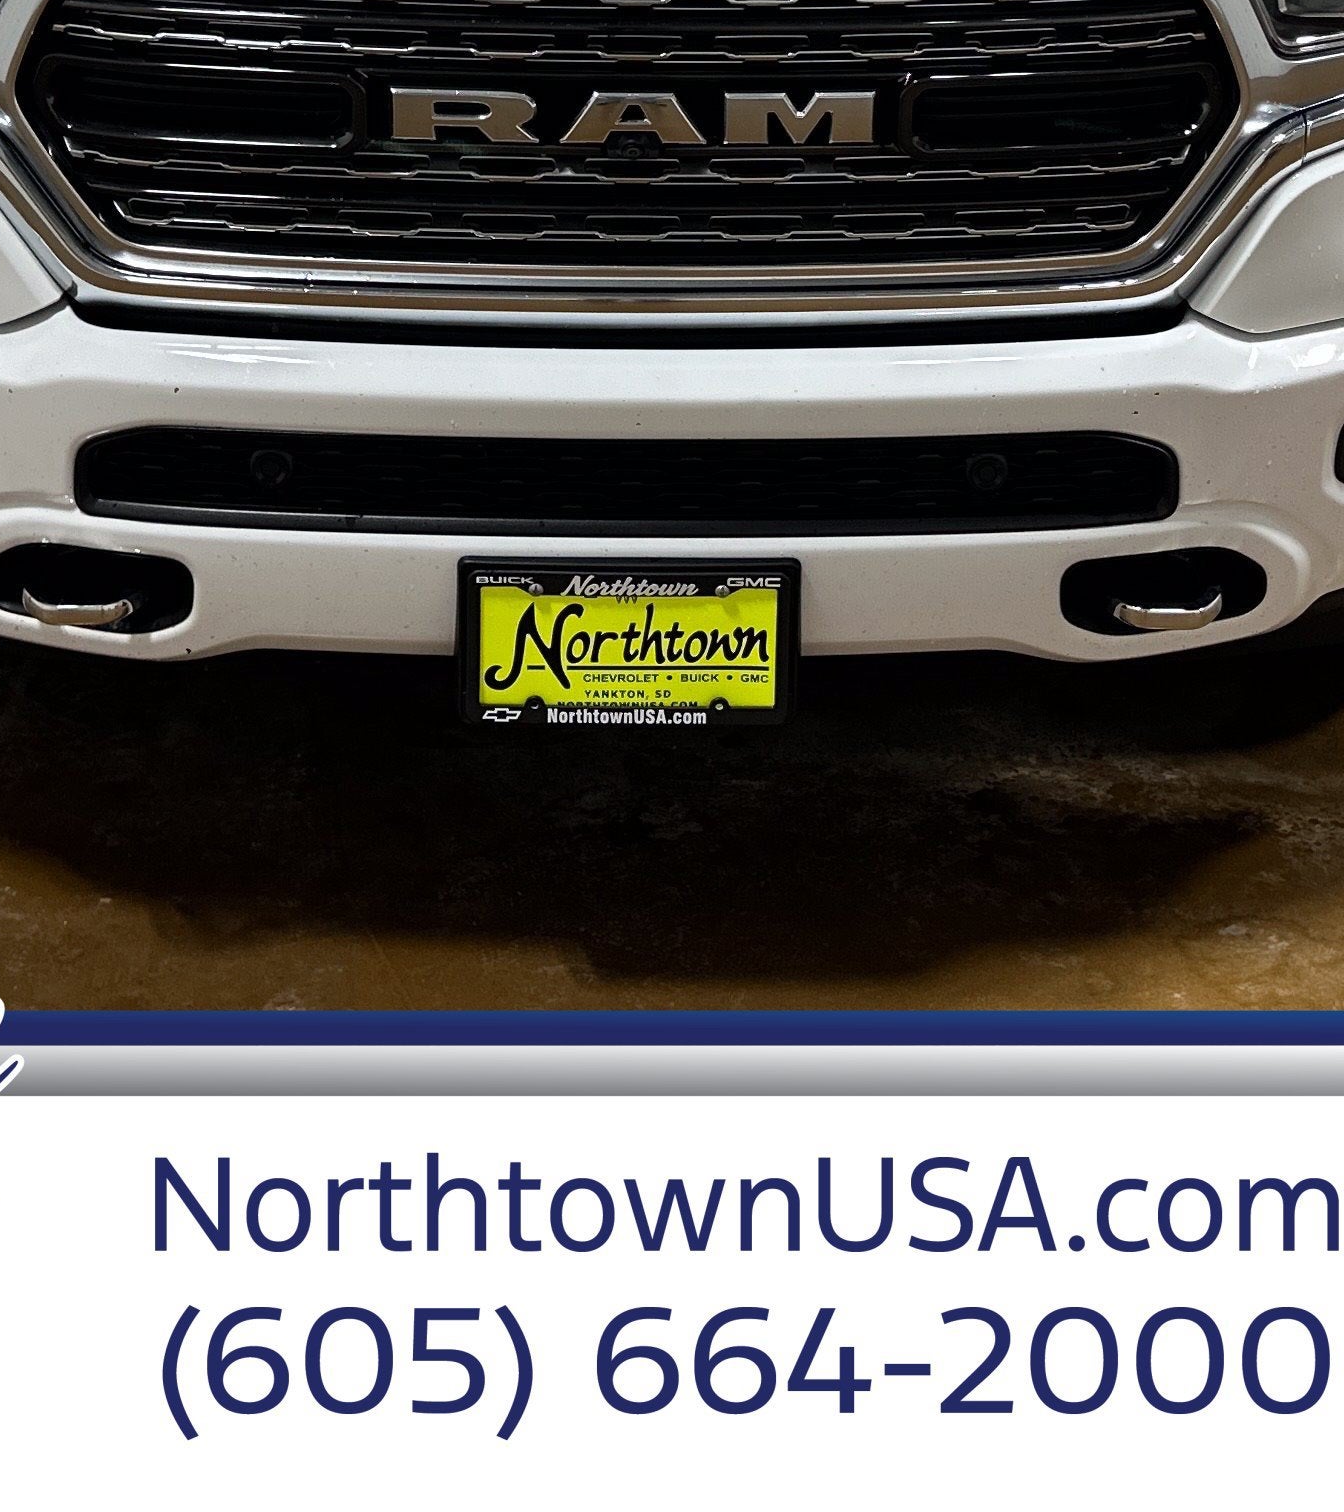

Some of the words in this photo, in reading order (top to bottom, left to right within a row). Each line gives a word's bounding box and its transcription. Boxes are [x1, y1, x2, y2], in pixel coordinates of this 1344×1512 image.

[389, 88, 876, 144] RAM
[475, 575, 534, 585] BUICK
[560, 575, 699, 597] Northtown
[726, 577, 782, 588] GMC
[484, 601, 770, 690] Northtown
[582, 673, 659, 683] CHEVROLET
[680, 673, 719, 683] BUICK
[740, 673, 769, 684] GMC
[584, 689, 650, 700] YANKTON,
[654, 690, 672, 699] SD
[547, 708, 707, 725] NorthtownUSA.com
